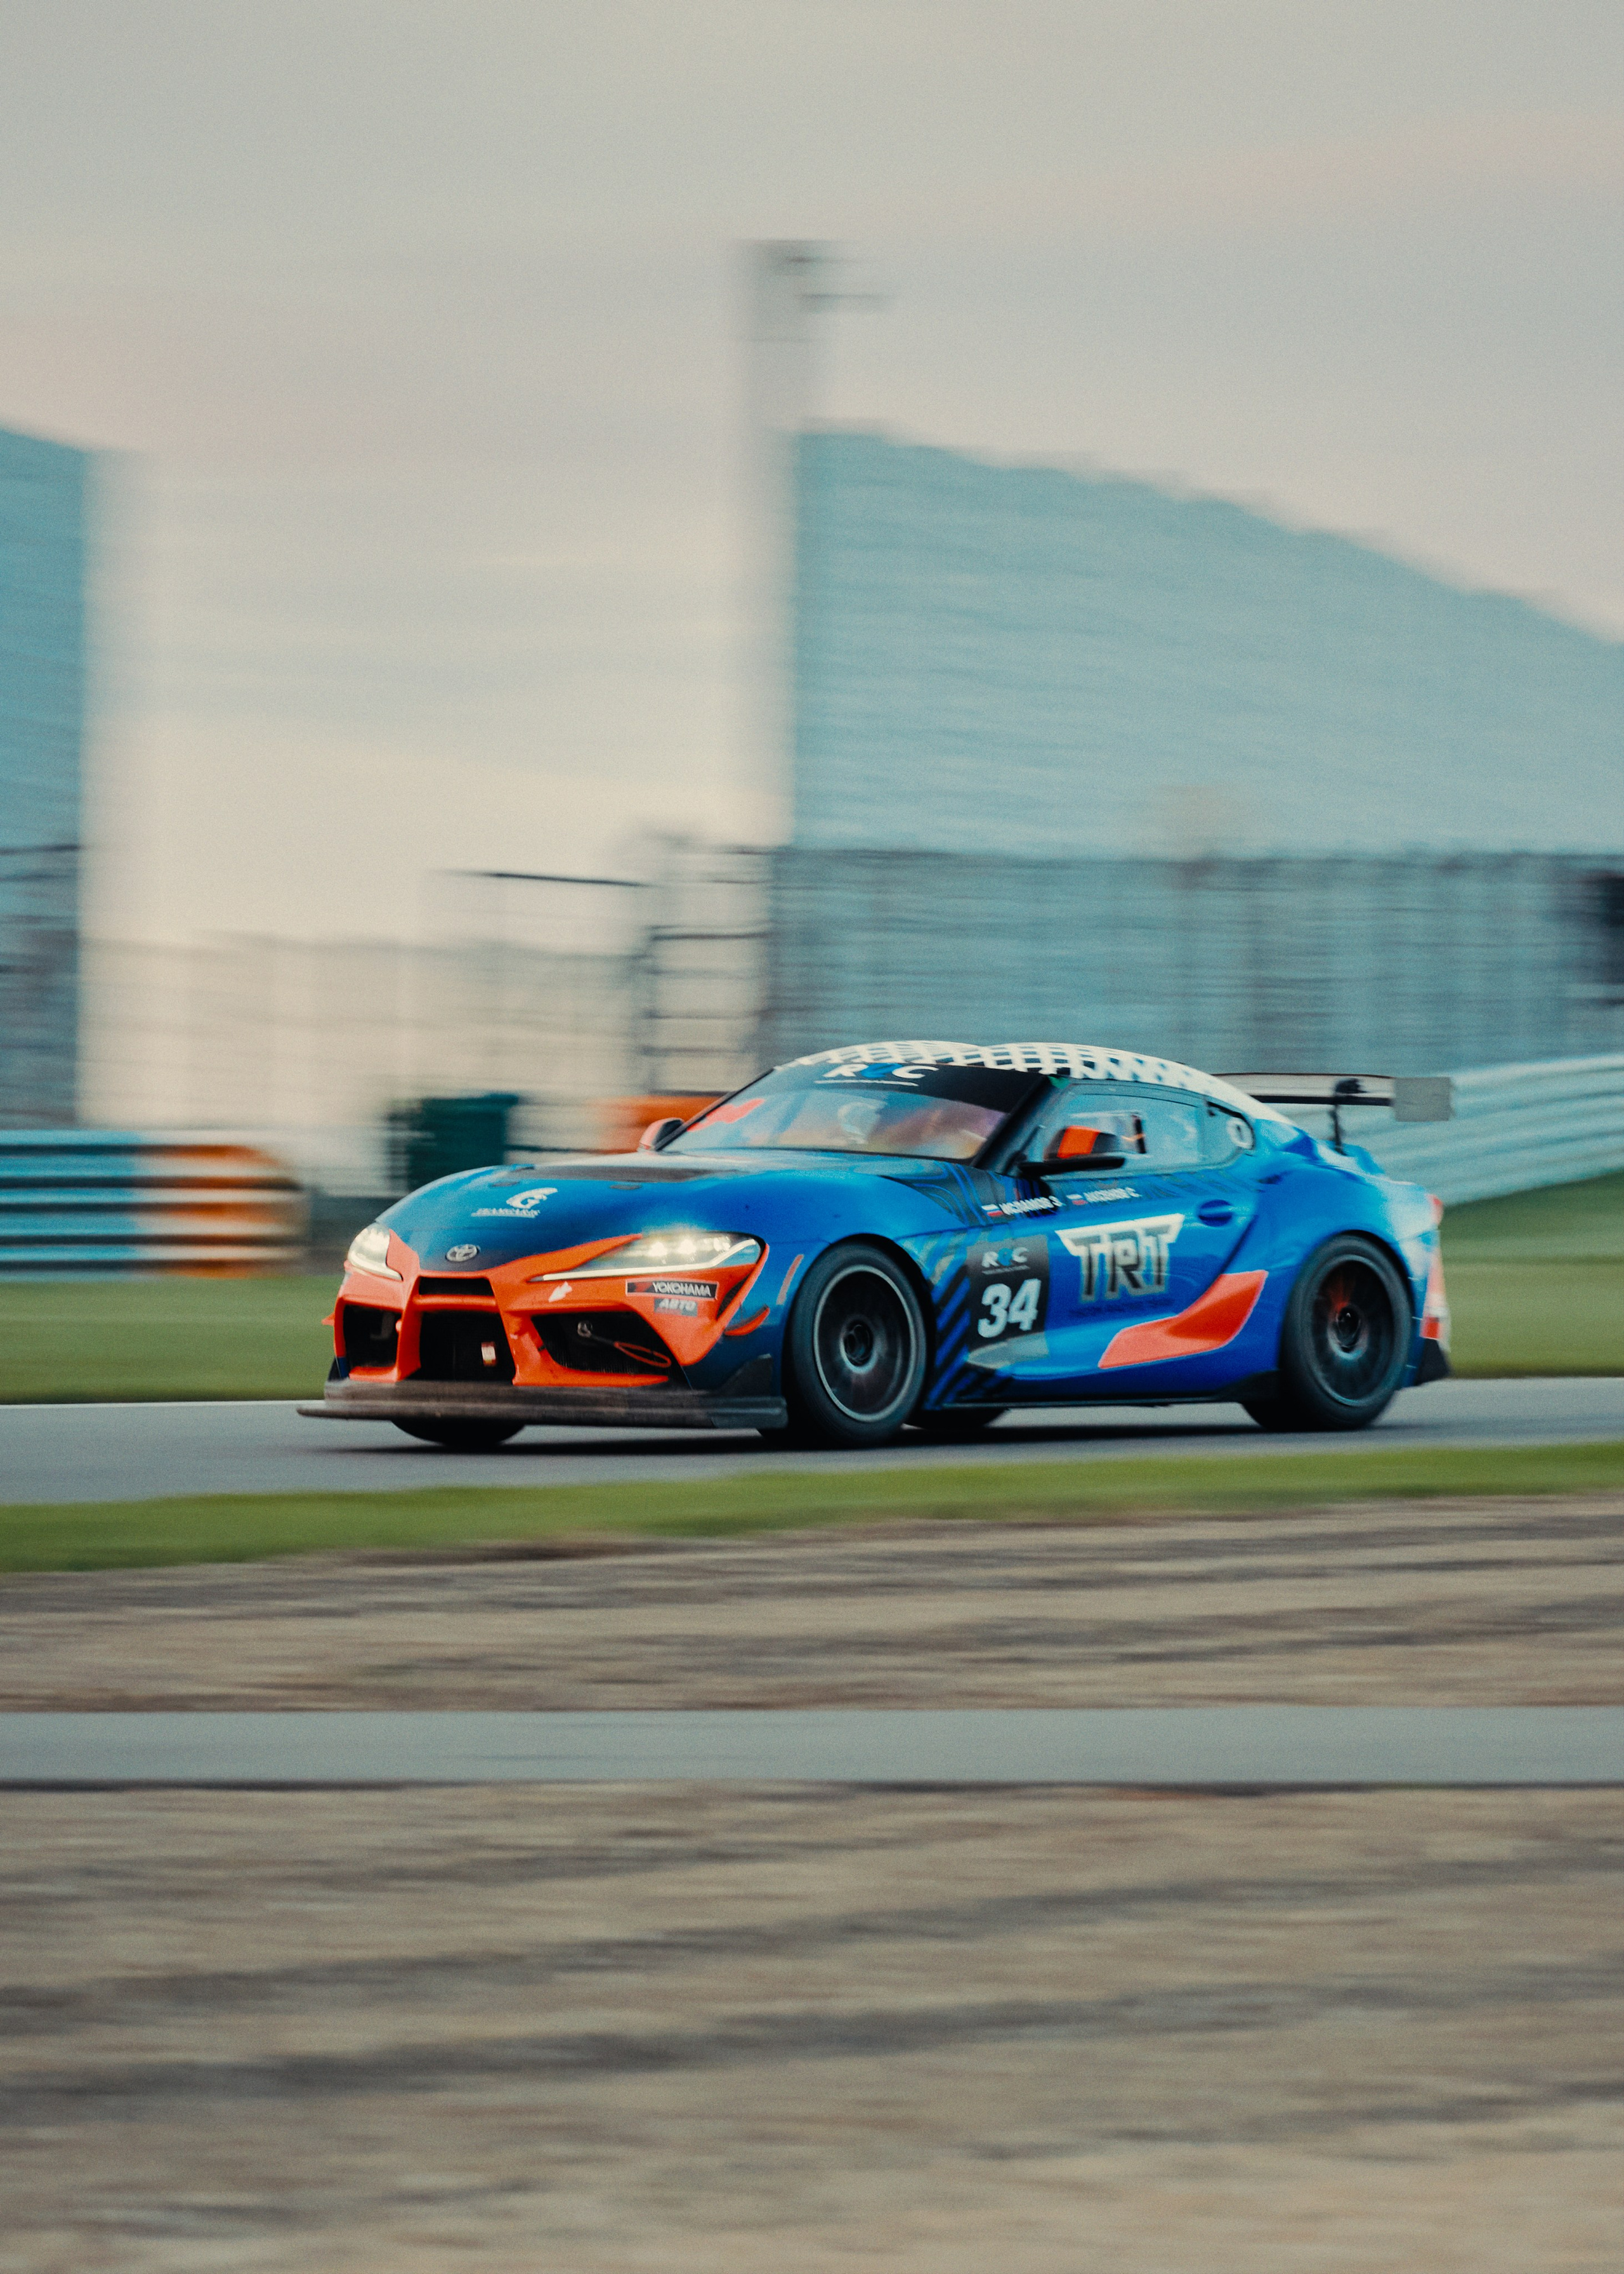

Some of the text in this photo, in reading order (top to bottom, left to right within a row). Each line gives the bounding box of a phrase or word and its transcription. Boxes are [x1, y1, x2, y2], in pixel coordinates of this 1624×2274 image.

[1054, 1213, 1185, 1300] TRT
[652, 1281, 711, 1297] YOKOHAMA
[978, 1277, 1042, 1338] 34
